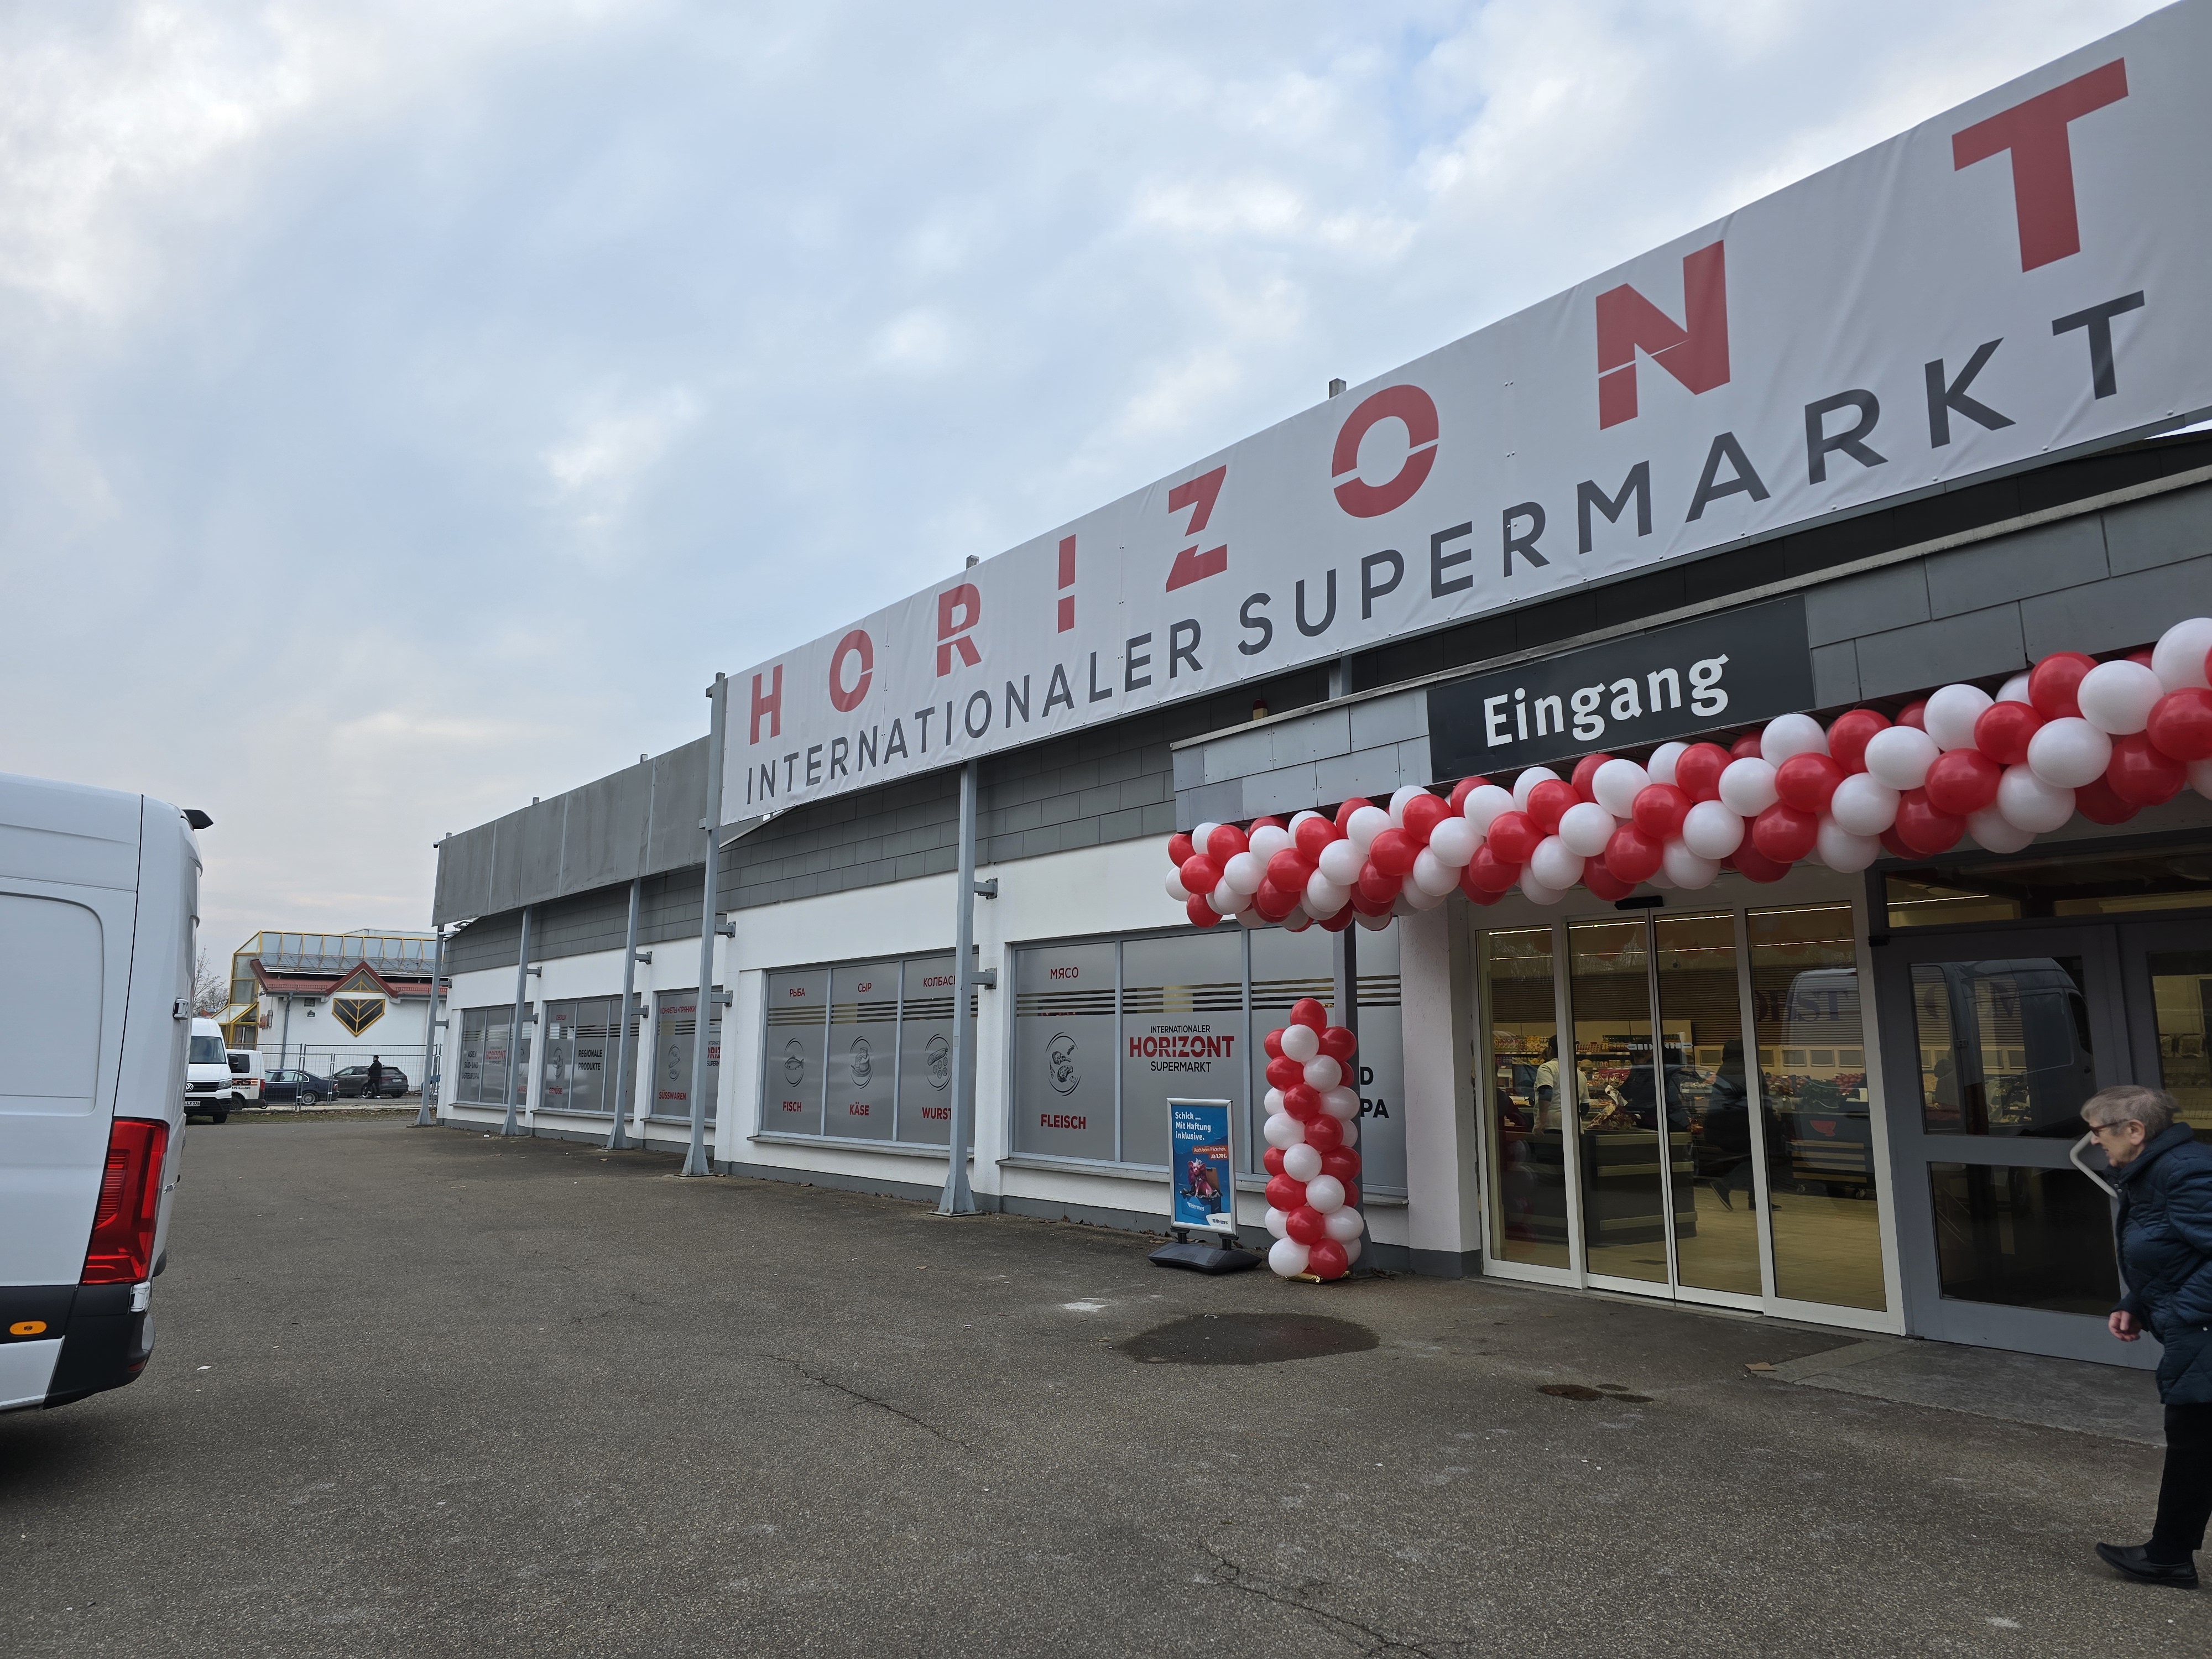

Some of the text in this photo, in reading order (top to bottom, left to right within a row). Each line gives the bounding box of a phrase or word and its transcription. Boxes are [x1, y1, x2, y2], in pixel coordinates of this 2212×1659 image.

[750, 57, 2128, 745] HORIZONT
[747, 290, 2145, 804] INTERNATIONALER SUPERMARKT
[1484, 654, 1729, 747] Eingang
[1050, 967, 1079, 979] МЯСО
[789, 988, 805, 997] РЫБА
[858, 982, 872, 993] СЫР
[1150, 1025, 1211, 1034] INTERNATIONALER
[1129, 1036, 1234, 1058] HORIZONT
[578, 1049, 602, 1058] REGIONALE
[578, 1062, 601, 1071] PRODUKTE
[1150, 1061, 1212, 1072] SUPERMARKT
[659, 1089, 686, 1100] SÜSSWAREN
[782, 1102, 802, 1112] FISCH
[849, 1102, 869, 1116] KÄSE
[1175, 1111, 1194, 1120] Schick
[1041, 1114, 1086, 1130] FLEISCH
[1186, 1122, 1211, 1133] Haftung
[1191, 1203, 1204, 1212] Hermes
